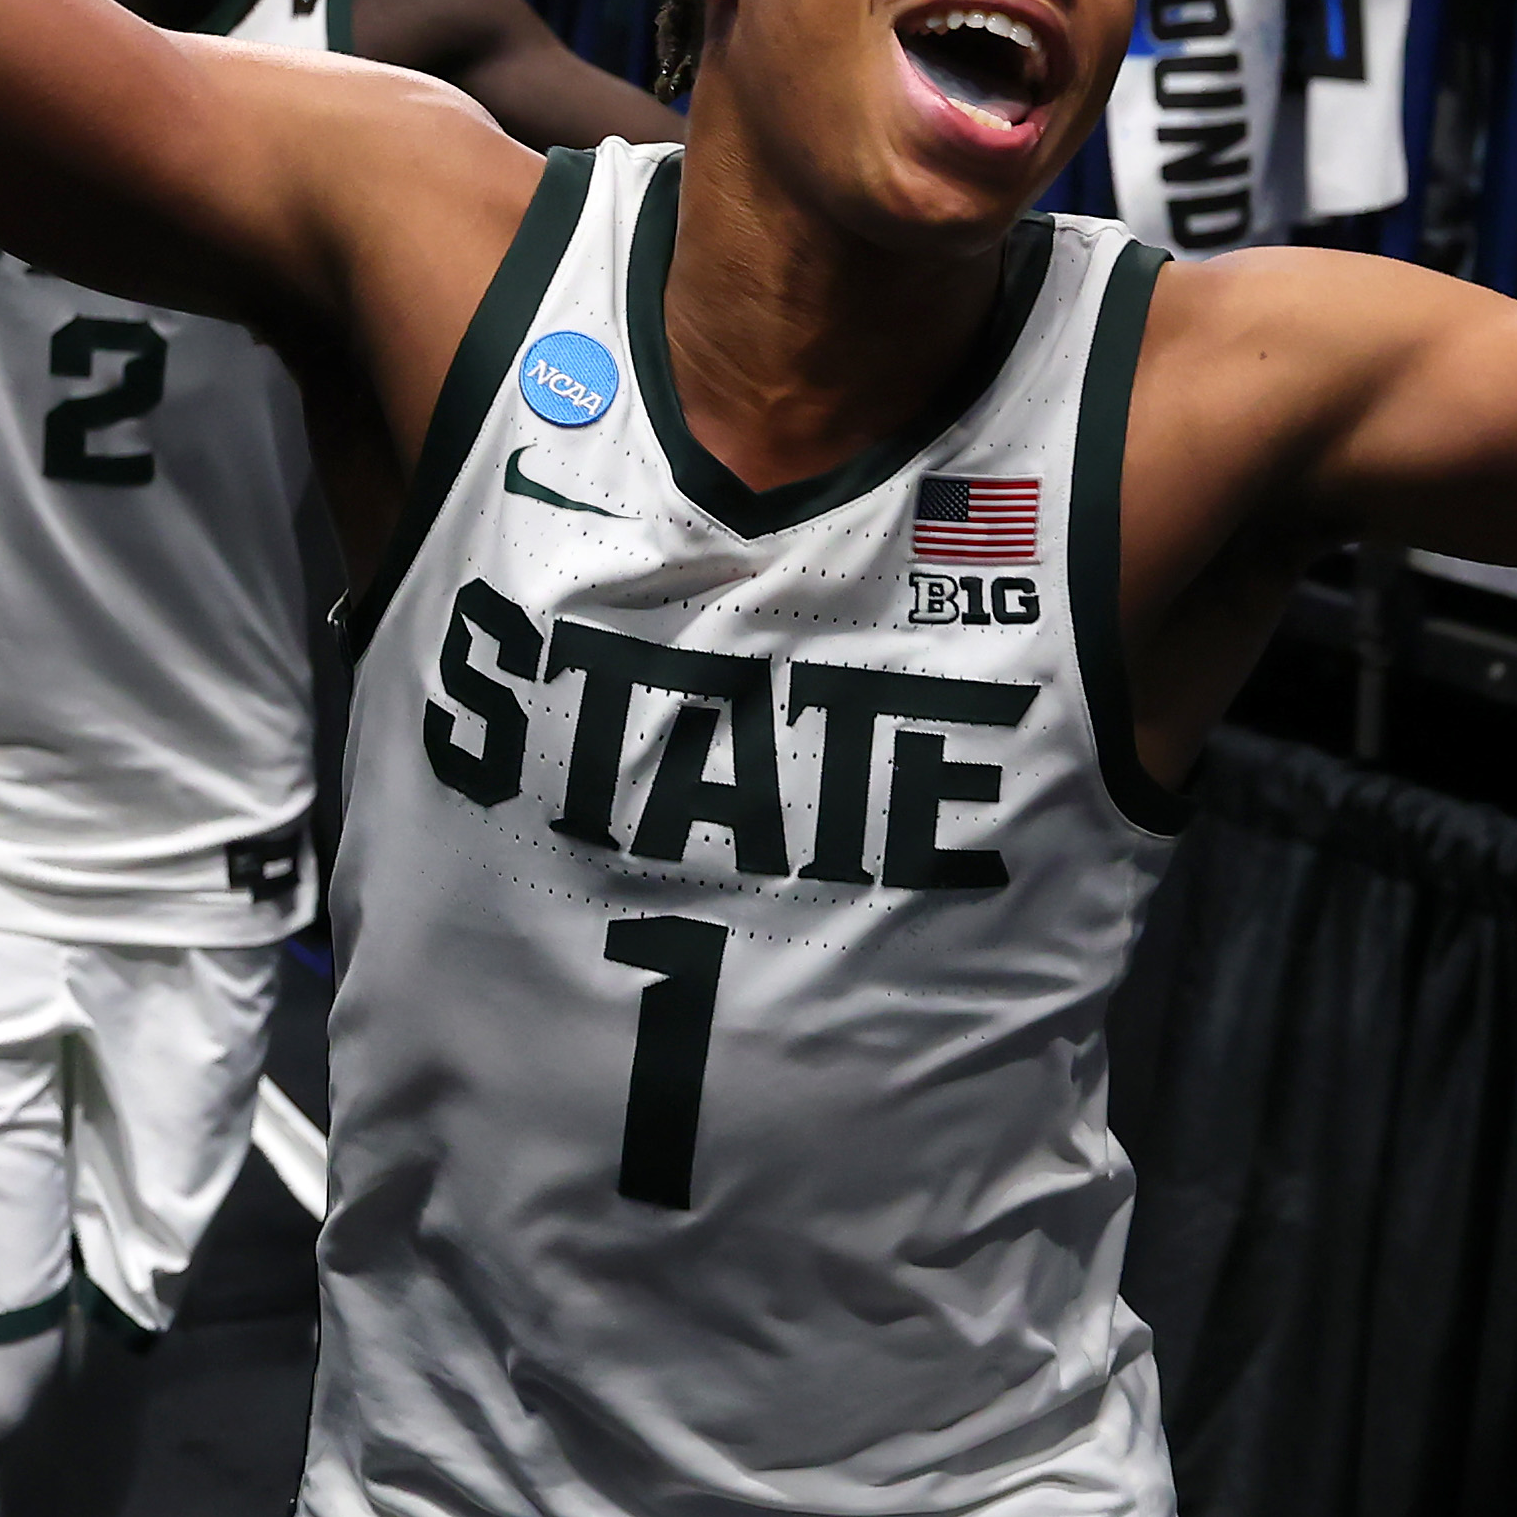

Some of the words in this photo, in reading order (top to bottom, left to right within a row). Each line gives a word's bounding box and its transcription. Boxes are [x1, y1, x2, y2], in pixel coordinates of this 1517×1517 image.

[42, 313, 168, 486] 2
[526, 358, 604, 416] NCAA
[422, 576, 1041, 891] STATE
[603, 914, 730, 1211] 1
